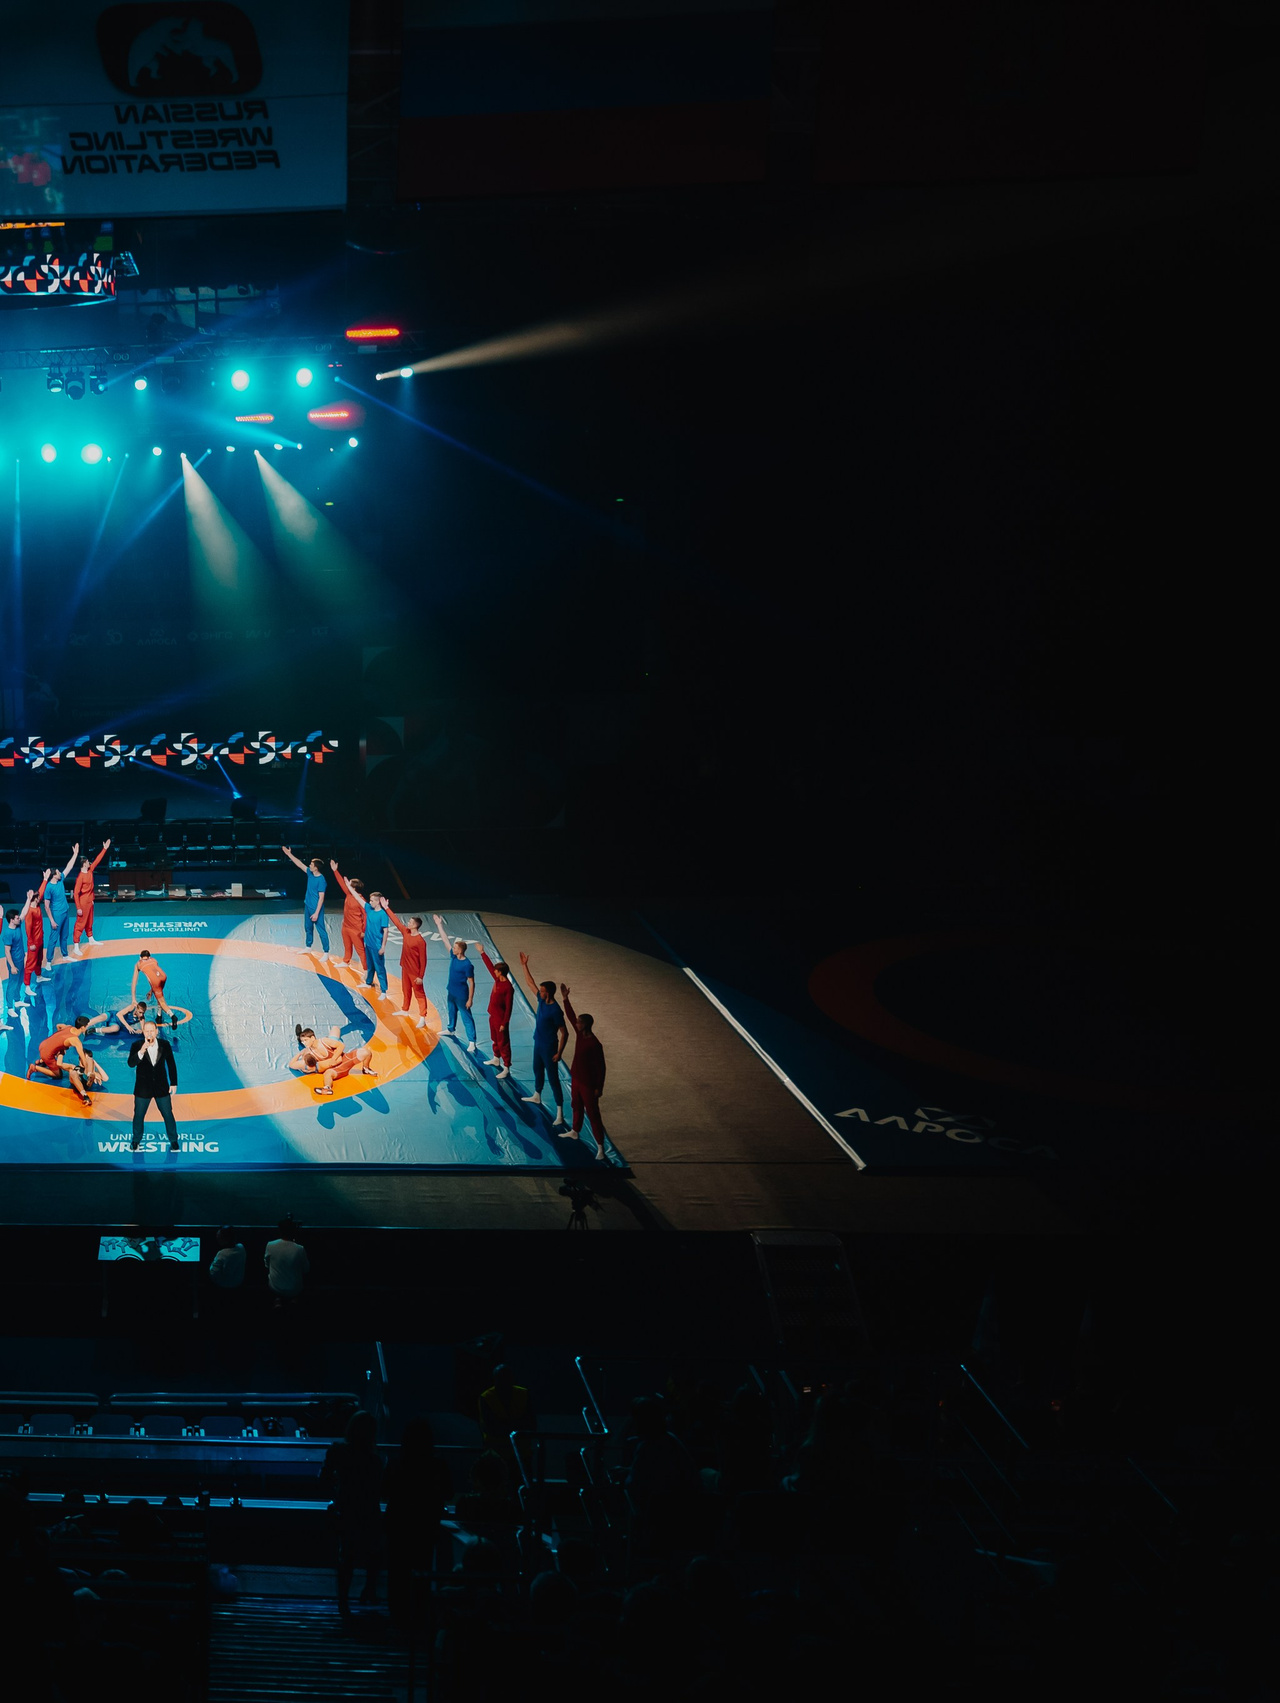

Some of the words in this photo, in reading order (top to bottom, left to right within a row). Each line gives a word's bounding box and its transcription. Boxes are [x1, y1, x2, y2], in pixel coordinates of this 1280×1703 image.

[123, 921, 208, 929] WRESTLING
[109, 1133, 155, 1141] UNIED
[158, 1133, 205, 1141] WRLD
